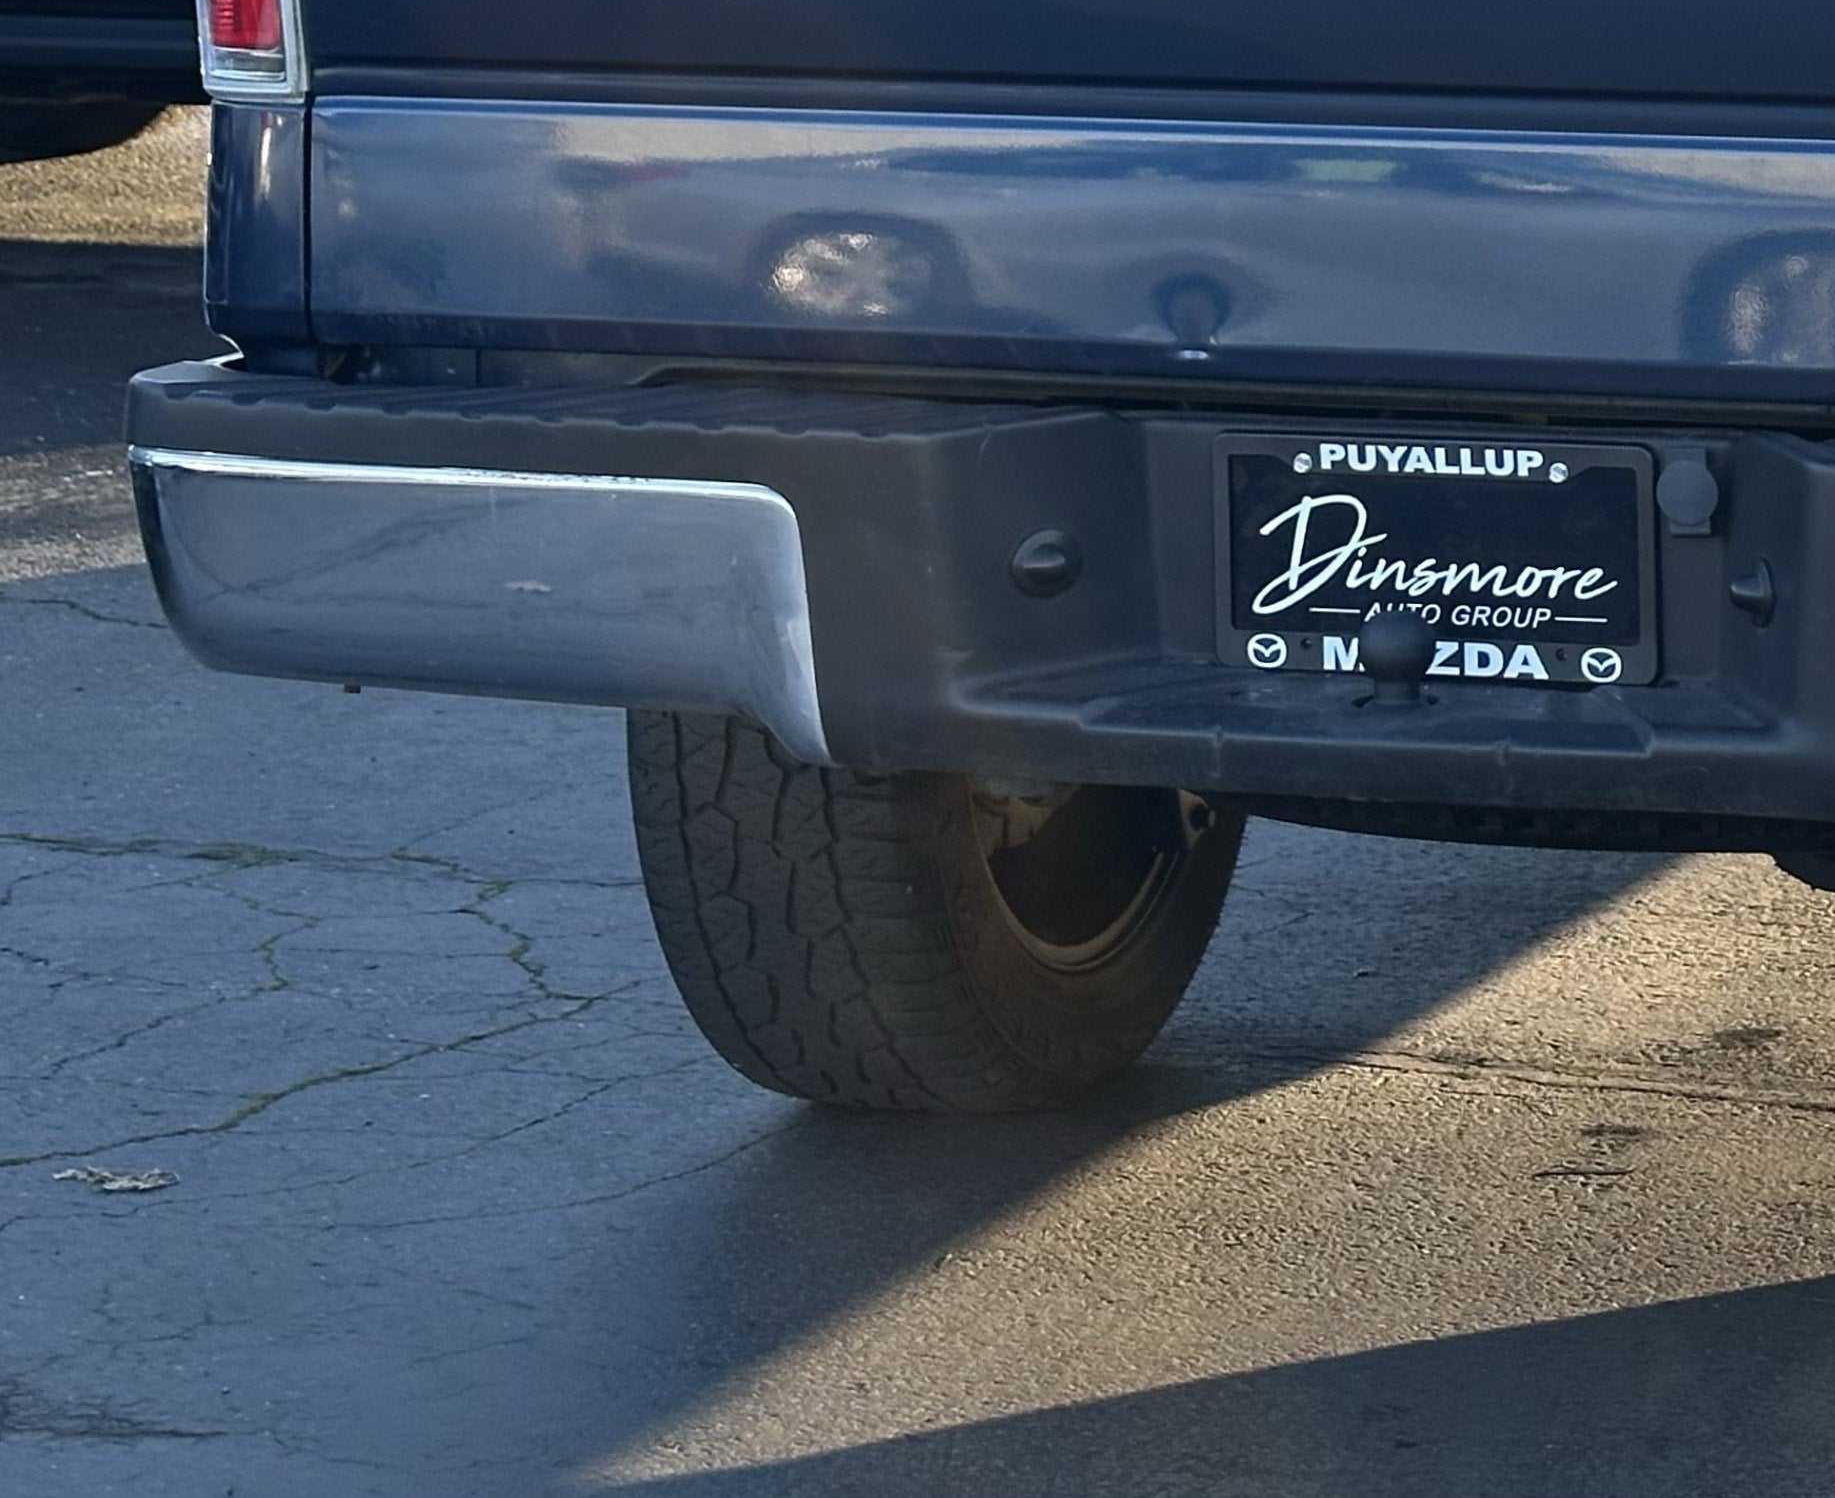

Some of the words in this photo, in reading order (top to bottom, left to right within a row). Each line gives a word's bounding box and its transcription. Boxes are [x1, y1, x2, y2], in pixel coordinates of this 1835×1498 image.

[1318, 442, 1545, 478] PUYALLUP
[1251, 493, 1619, 615] Dinsmore
[1450, 604, 1553, 630] GROUP
[1323, 635, 1551, 681] MZDA
